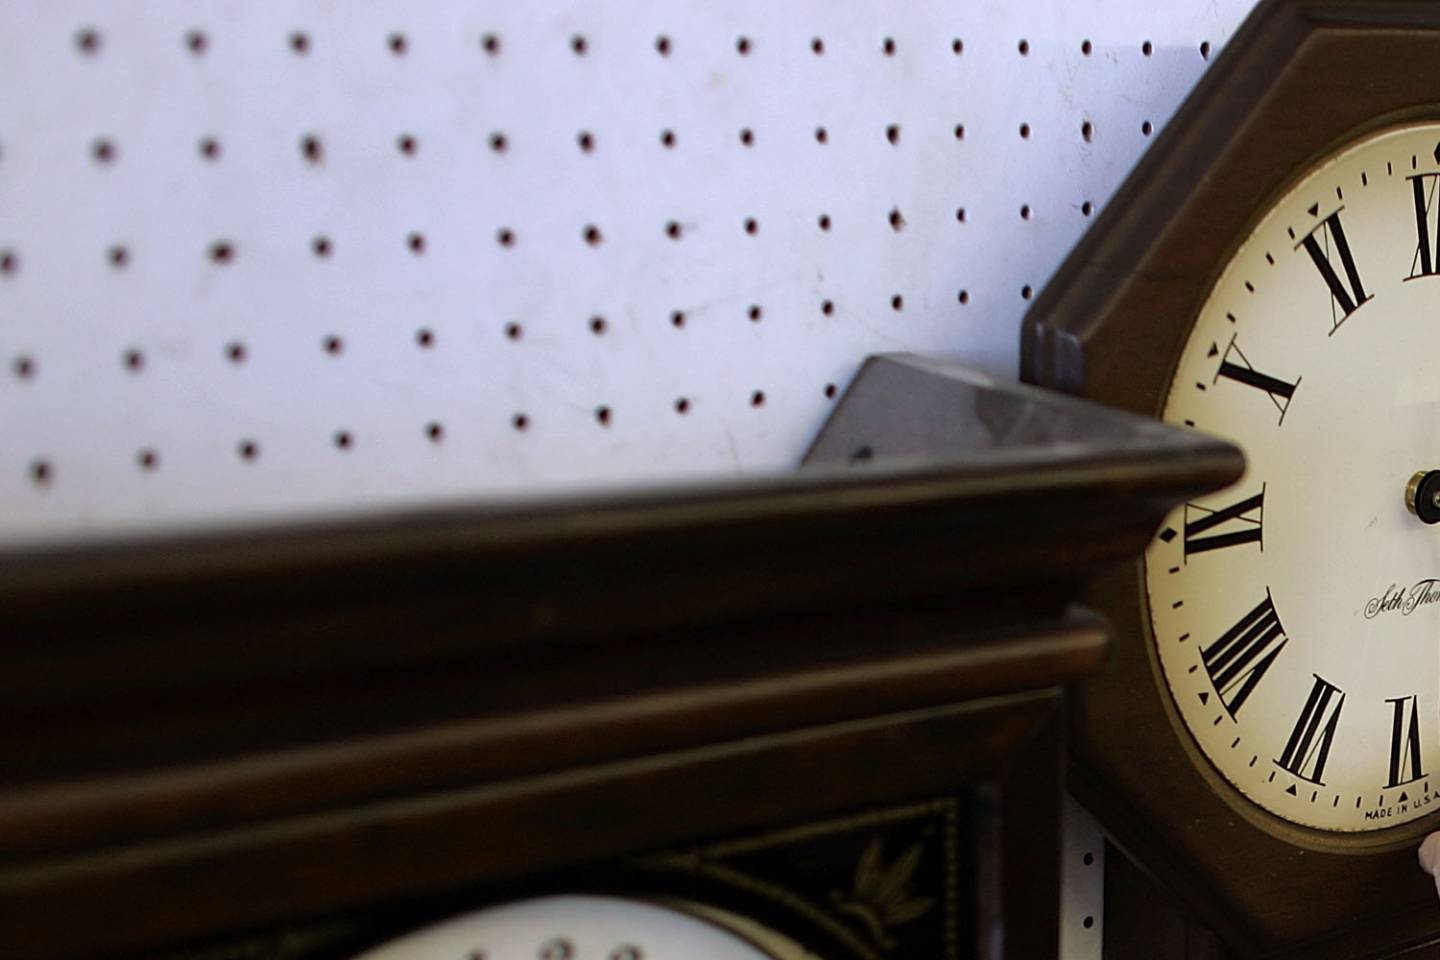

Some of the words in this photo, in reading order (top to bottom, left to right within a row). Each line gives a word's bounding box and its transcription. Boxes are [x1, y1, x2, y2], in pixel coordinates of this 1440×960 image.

[1294, 204, 1375, 337] XI
[1213, 332, 1302, 428] X
[1183, 482, 1266, 566] IX
[1197, 586, 1288, 724] VIII
[1272, 673, 1346, 787] VII
[1382, 694, 1428, 790] VI
[1365, 807, 1393, 820] MADE
[1397, 803, 1409, 815] IN
